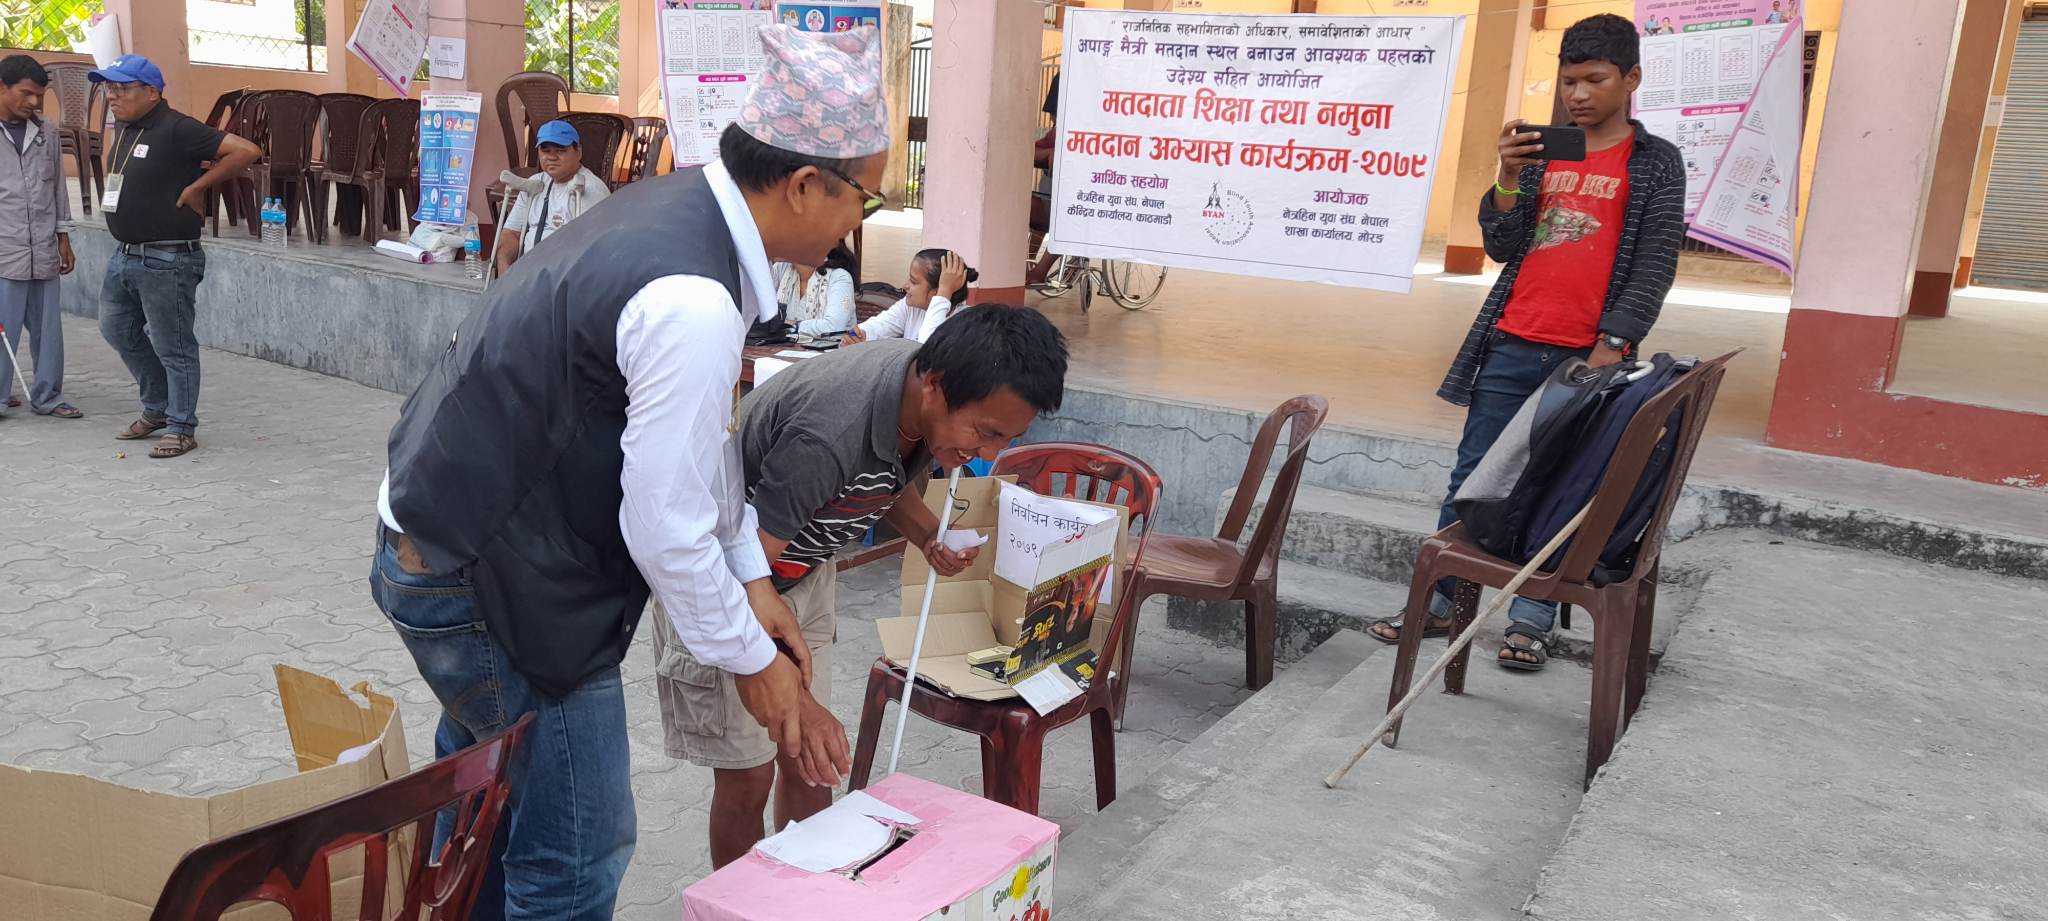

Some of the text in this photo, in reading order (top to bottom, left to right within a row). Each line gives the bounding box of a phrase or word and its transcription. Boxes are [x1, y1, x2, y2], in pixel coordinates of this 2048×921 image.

[1176, 21, 1241, 36] सहभागिताको
[1245, 22, 1292, 40] अधिकार,
[1298, 22, 1372, 40] समावेशिताको
[1376, 27, 1414, 40] आधार
[1120, 34, 1149, 56] मैत्री
[1154, 42, 1200, 60] मतदान
[1205, 45, 1240, 61] स्थल
[1246, 47, 1298, 62] बनाउन
[1304, 48, 1371, 65] आवश्यक
[1377, 45, 1437, 67] पहलको
[1213, 66, 1251, 87] सहित
[1257, 69, 1324, 90] आयोजित
[1102, 87, 1395, 137] मतदाता शिक्षा तथा नमुना
[1066, 130, 1143, 159] मतदान
[1148, 136, 1234, 167] अभ्यास
[1090, 169, 1170, 190] आर्थिक सहयोग
[1107, 195, 1123, 207] युवा
[1141, 196, 1166, 210] नेपाल
[1312, 187, 1370, 206] आयोजक
[1319, 212, 1337, 226] युवा
[1360, 213, 1390, 228] नेपाल
[1284, 226, 1310, 239] शाखा
[1010, 497, 1050, 528] निर्वाचन
[1010, 533, 1039, 558] २०७९
